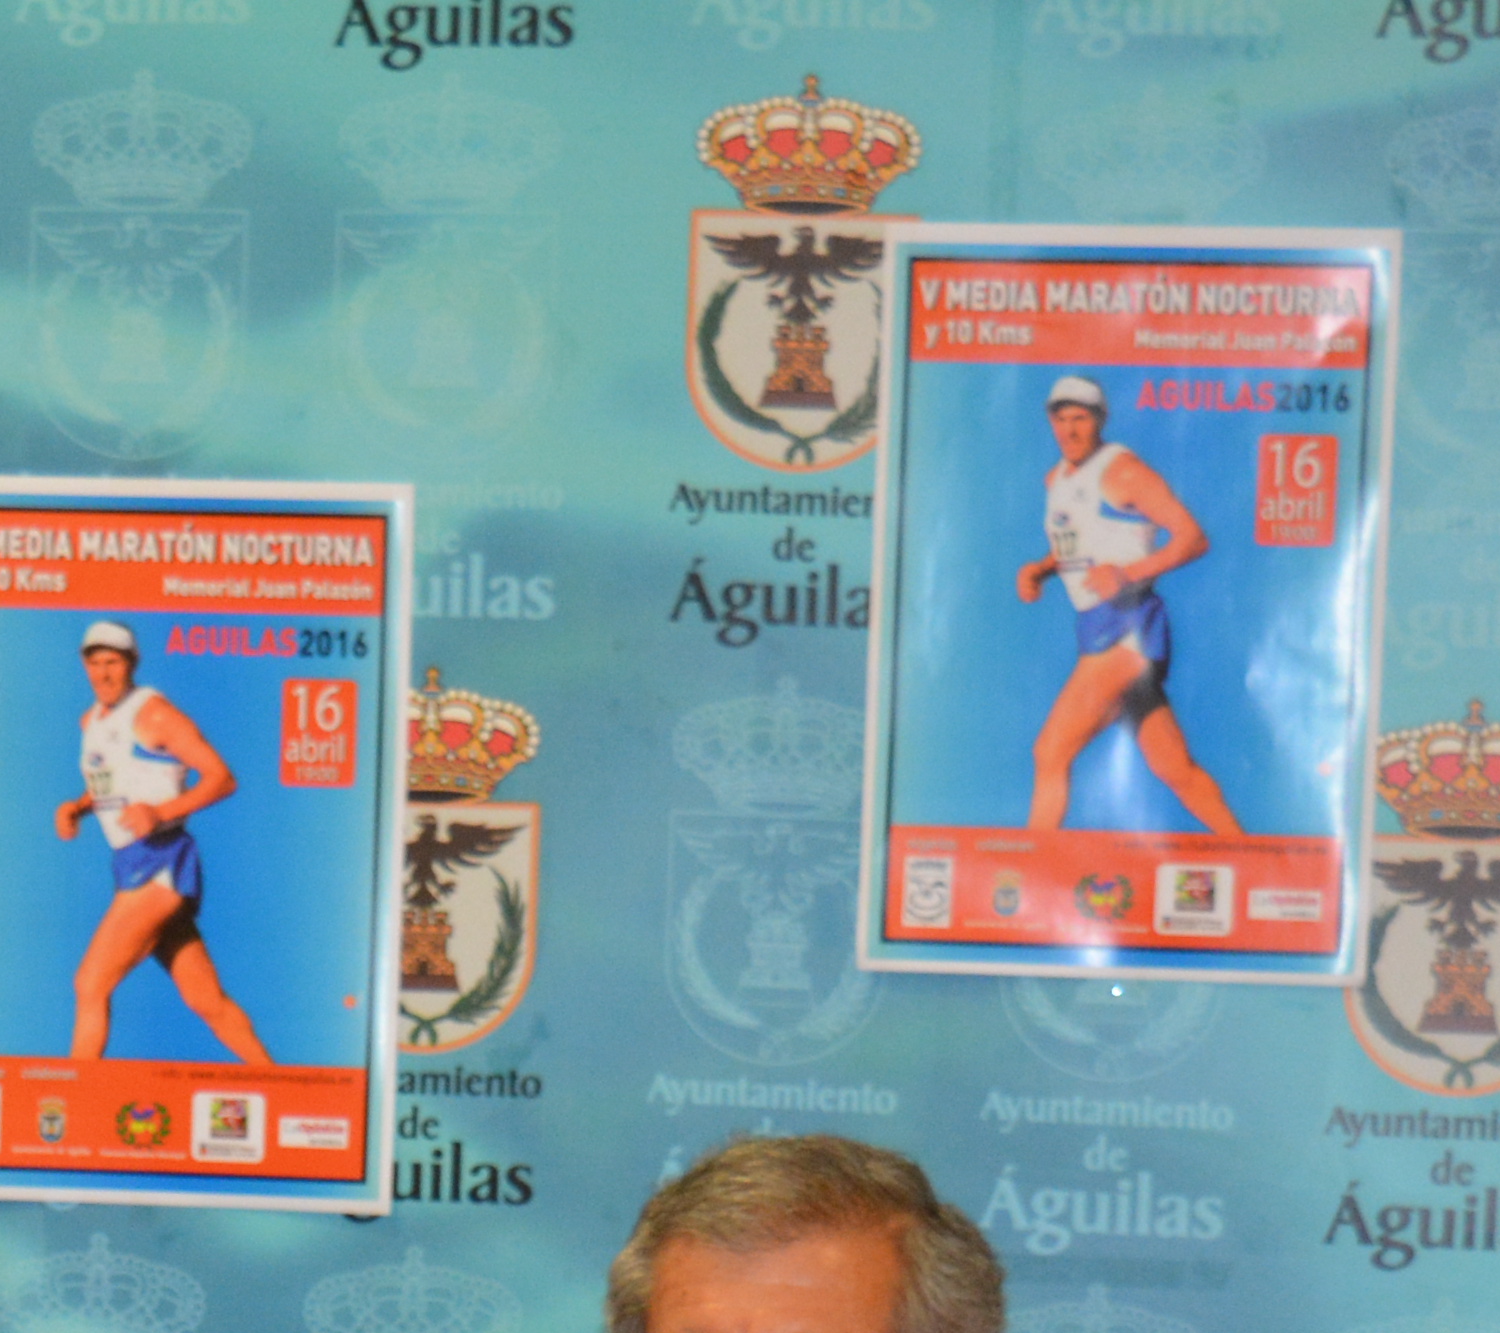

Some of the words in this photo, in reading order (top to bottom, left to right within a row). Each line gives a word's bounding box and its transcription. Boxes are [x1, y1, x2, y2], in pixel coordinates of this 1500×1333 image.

[920, 278, 942, 310] V
[946, 280, 1039, 312] MEDIA
[1045, 273, 1190, 315] MARATÓN
[1197, 283, 1359, 317] NOCTURNA
[925, 323, 941, 350] y
[946, 319, 975, 345] 10
[978, 319, 1033, 346] Kms
[1134, 329, 1226, 351] Memorial
[1231, 331, 1276, 352] Juan
[1269, 442, 1323, 489] 16
[1261, 493, 1324, 521] abril
[79, 521, 217, 564] MARATÓN
[222, 532, 376, 567] NOCTURNA
[773, 528, 815, 562] de
[15, 567, 67, 593] Kms
[163, 576, 250, 598] Memorial
[254, 580, 297, 600] Juan
[302, 580, 375, 600] Palazón
[669, 563, 872, 647] Águila
[291, 686, 344, 732] 16
[285, 736, 345, 764] abril
[397, 1066, 541, 1101] amiento
[400, 1107, 439, 1141] de
[980, 1089, 1234, 1133] Ayuntamiento
[1083, 1136, 1128, 1172] de
[1429, 1151, 1474, 1189] de
[391, 1142, 534, 1205] uilas
[980, 1167, 1225, 1254] Águilas
